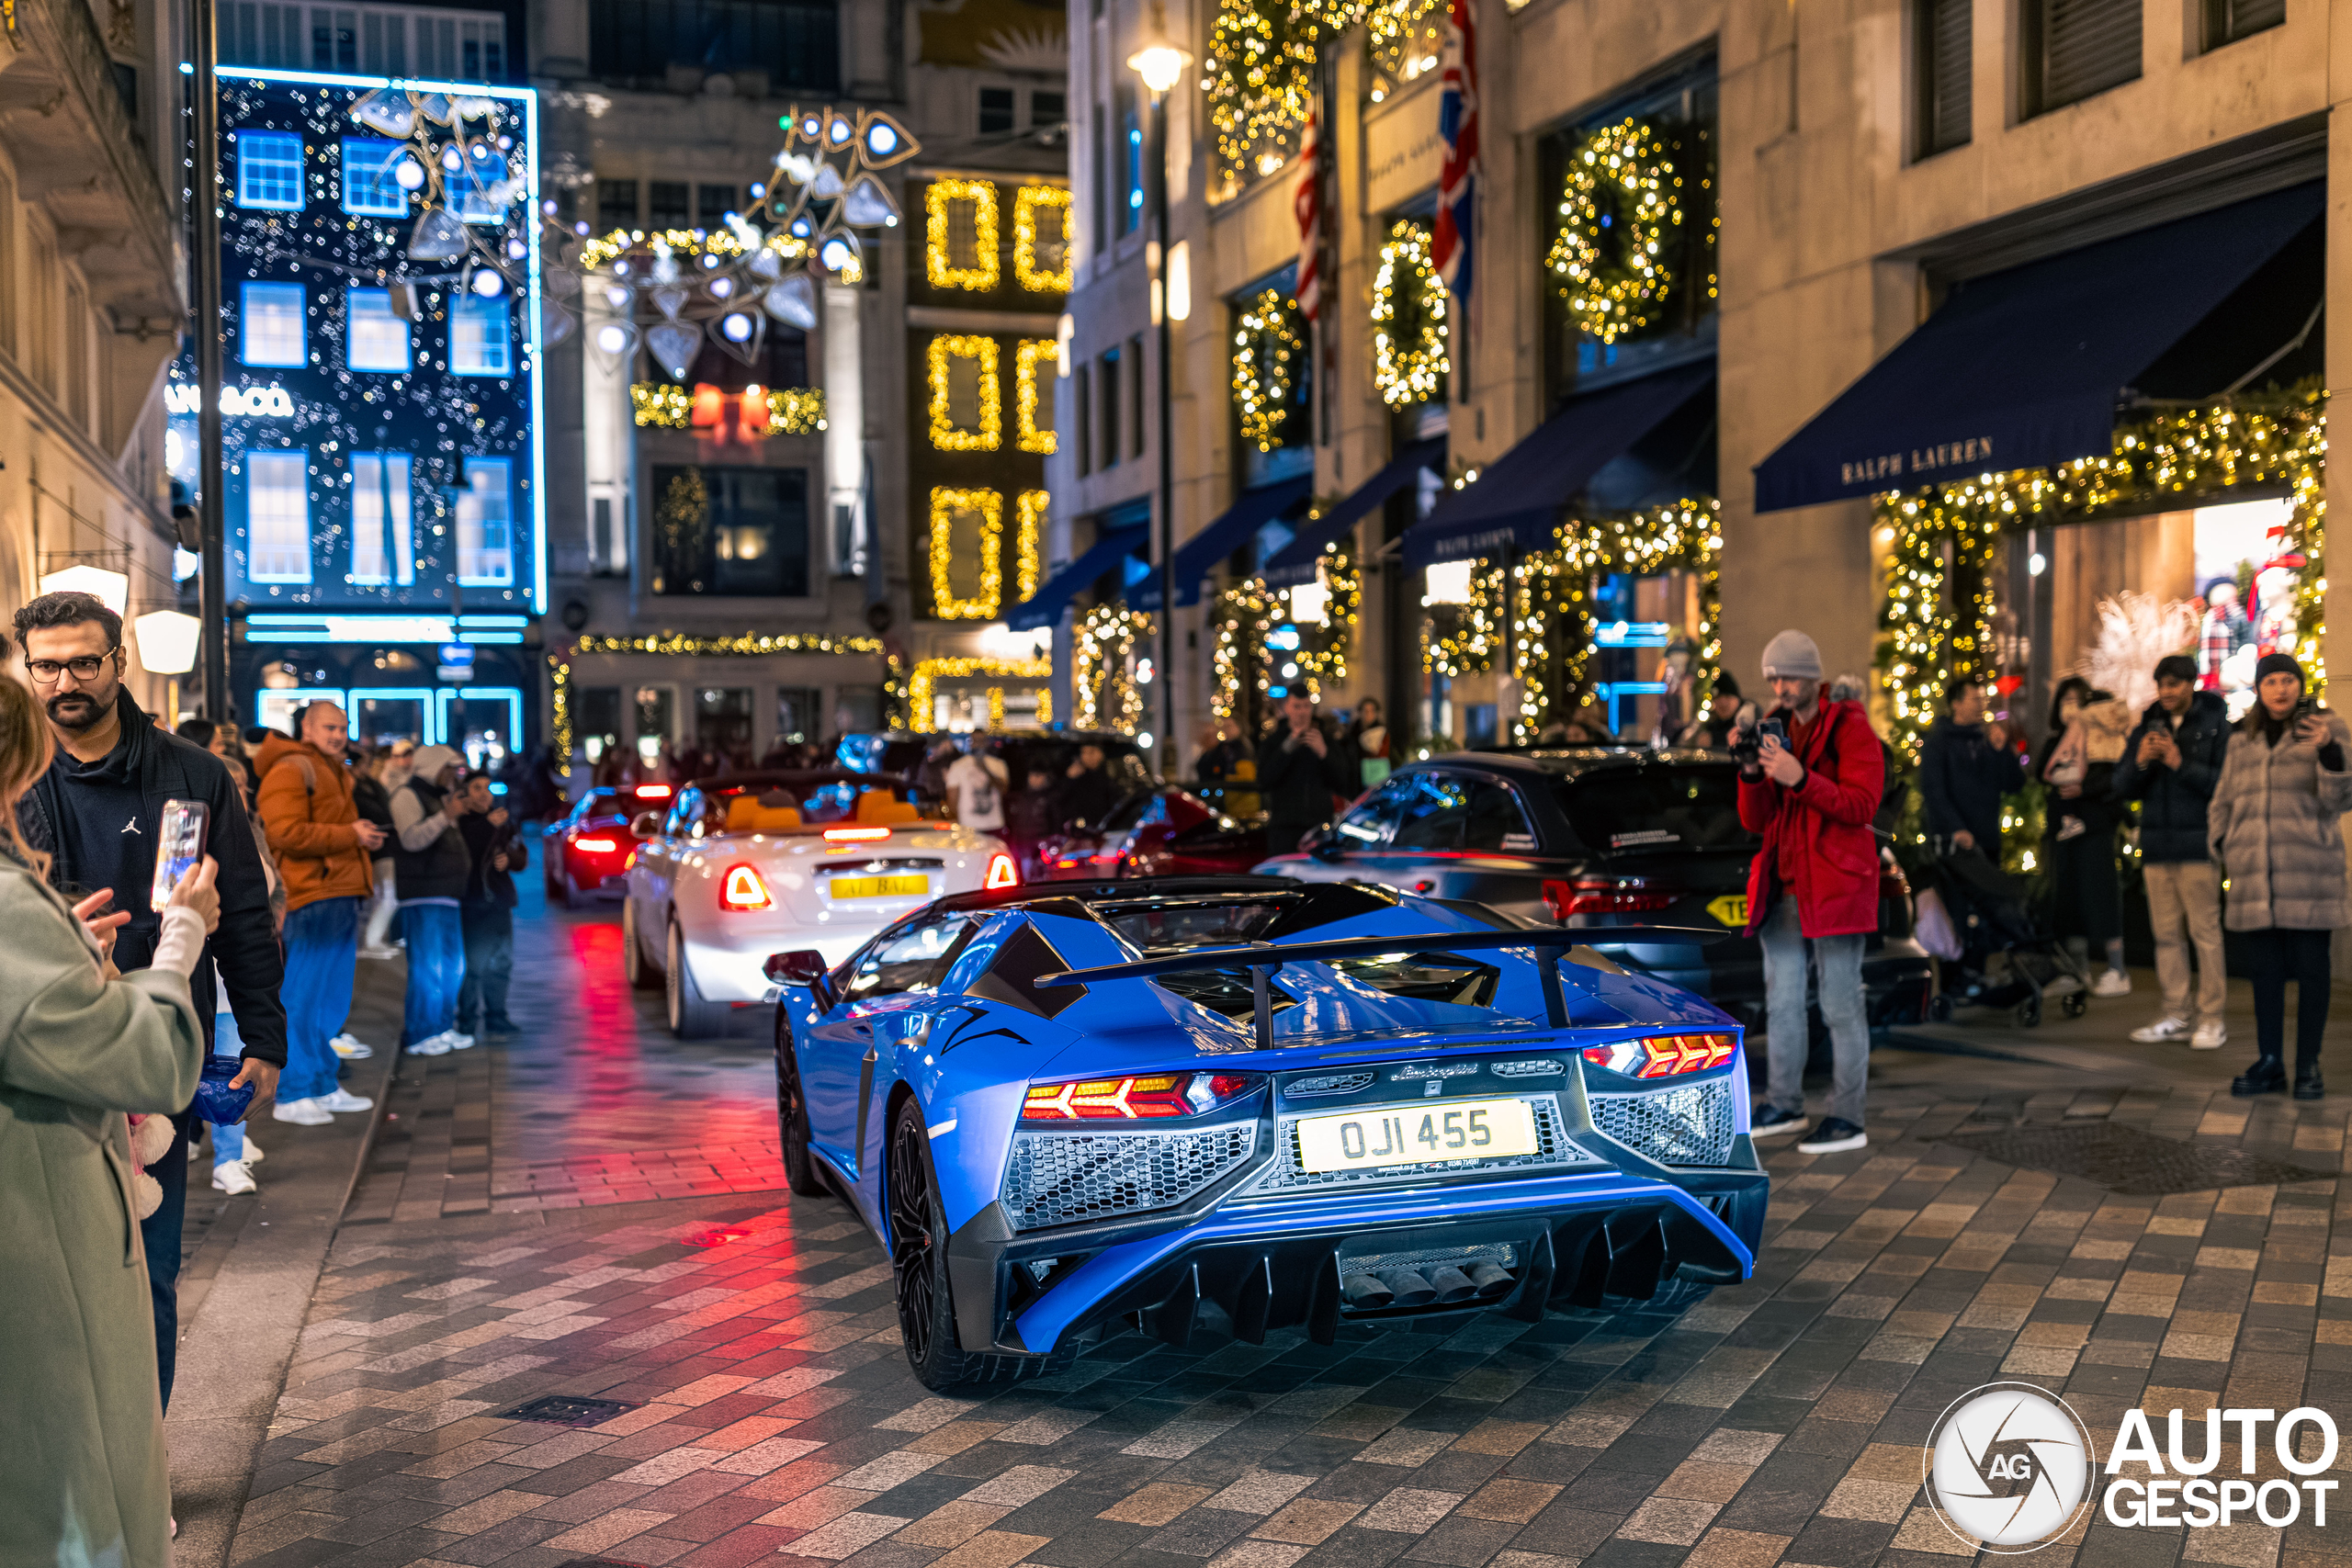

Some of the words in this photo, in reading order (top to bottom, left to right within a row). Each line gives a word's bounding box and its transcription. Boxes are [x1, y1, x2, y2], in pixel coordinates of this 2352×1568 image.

[1841, 453, 1903, 486] RALPH
[1911, 435, 1993, 473] LAUREN
[1390, 1064, 1478, 1081] Lamborghini
[1418, 1110, 1491, 1150] 455
